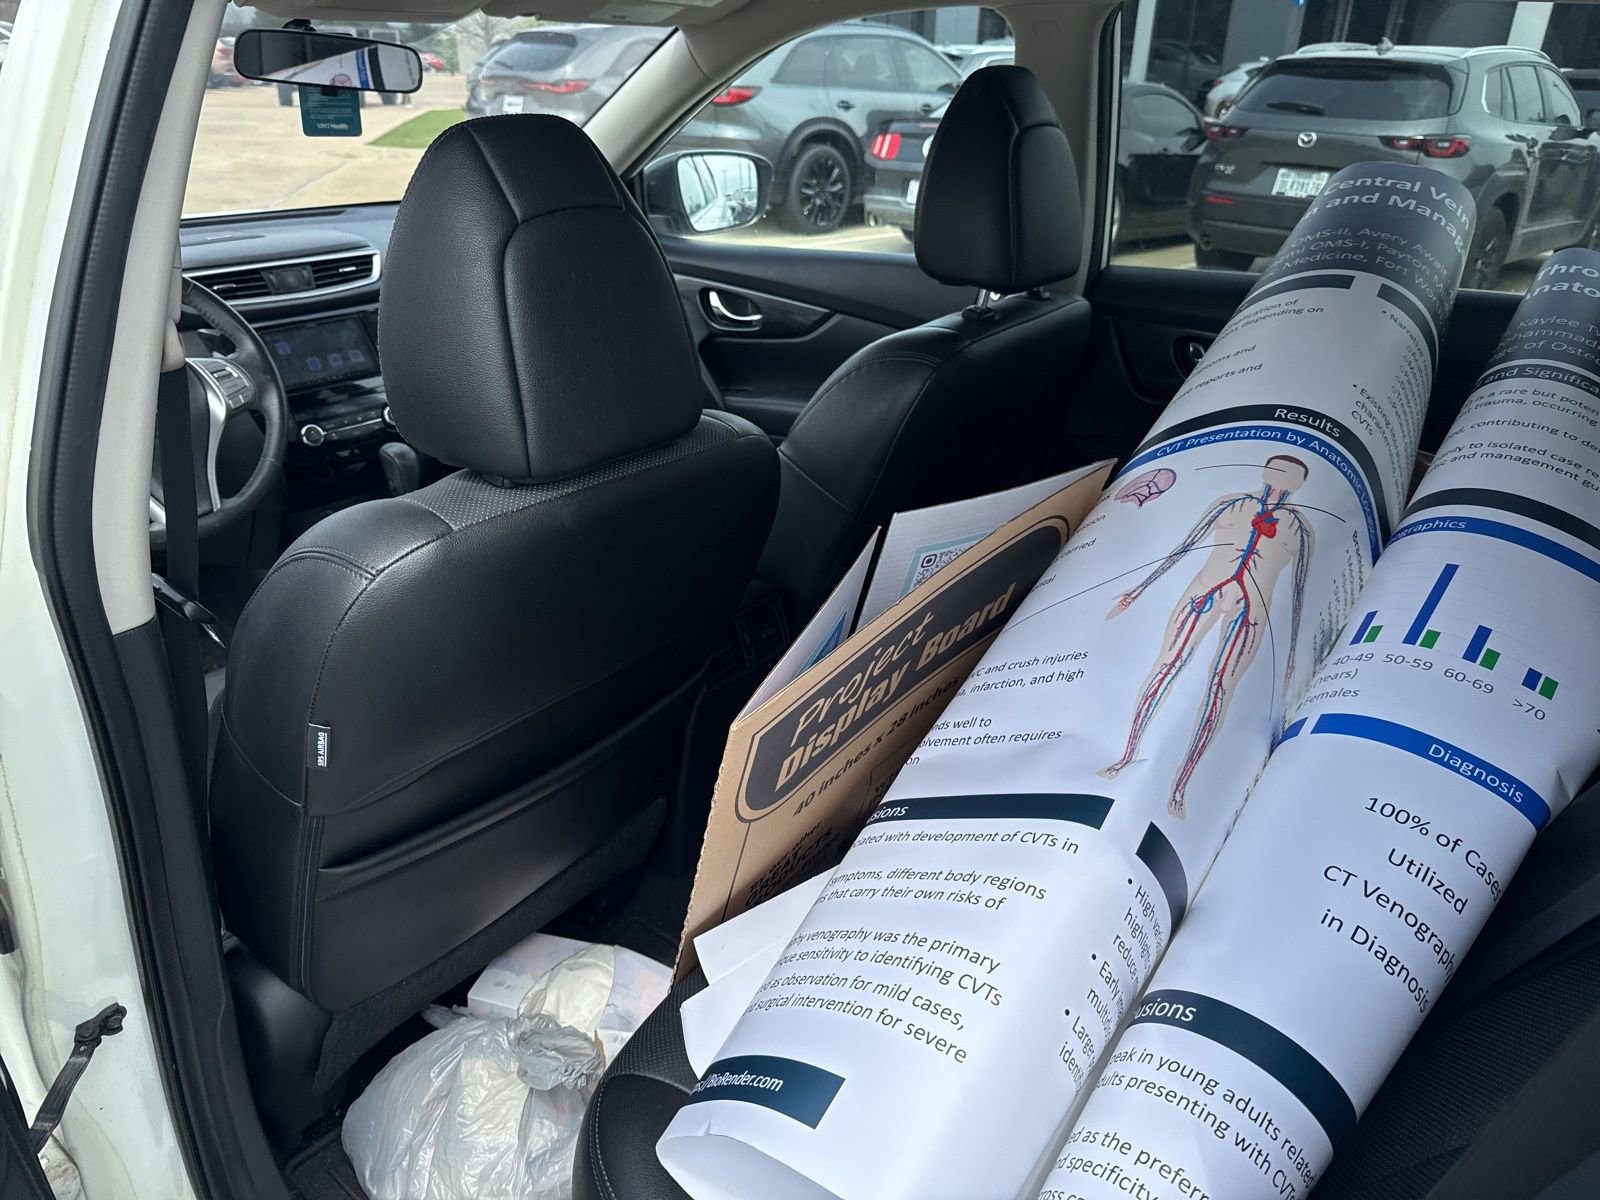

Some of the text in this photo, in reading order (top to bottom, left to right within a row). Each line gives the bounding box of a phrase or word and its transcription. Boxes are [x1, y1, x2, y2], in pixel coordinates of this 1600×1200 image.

[1324, 176, 1421, 196] Central
[1429, 185, 1470, 230] Vein
[1326, 192, 1380, 209] and
[1387, 195, 1466, 260] Manag
[1359, 227, 1410, 246] Avery
[1282, 251, 1368, 271] Medicine,
[1375, 255, 1409, 276] Fort
[1376, 242, 1431, 276] Payton
[1241, 306, 1304, 329] depending
[1307, 306, 1324, 314] on
[1285, 299, 1299, 308] of
[1233, 344, 1257, 357] and
[1523, 340, 1547, 350] of
[1194, 369, 1236, 390] reports
[1238, 362, 1263, 375] and
[1359, 388, 1391, 430] Existing
[1498, 388, 1529, 396] rare
[1531, 388, 1556, 400] but
[1273, 407, 1342, 438] Results
[1351, 410, 1374, 437] CVTs
[1474, 397, 1598, 428] trauma, occurring
[1470, 418, 1559, 437] contributing
[1562, 431, 1578, 442] to
[1156, 427, 1364, 496] CVT Presentation by Anatomic
[1449, 451, 1478, 464] and
[1480, 451, 1579, 481] management
[1468, 441, 1484, 450] to
[1487, 440, 1548, 457] isolated
[1550, 452, 1583, 470] case
[985, 664, 1007, 675] and
[1007, 656, 1040, 670] crush
[1041, 650, 1089, 665] injuries
[775, 582, 1016, 794] Display Board
[790, 611, 935, 748] Project
[970, 677, 1027, 694] infarction,
[1029, 672, 1055, 686] and
[1056, 667, 1084, 683] high
[1332, 652, 1547, 721] 40-49 50-59 60-69 >70
[952, 716, 977, 729] well
[980, 717, 992, 728] to
[973, 732, 1006, 745] often
[1008, 729, 1063, 744] requires
[317, 731, 325, 755] AIRBAG
[792, 790, 816, 818] 40
[817, 743, 872, 796] inches
[886, 713, 909, 735] 28
[1428, 742, 1524, 804] Diagnosis
[884, 831, 911, 843] with
[912, 830, 998, 844] development
[1001, 830, 1020, 843] of
[1020, 831, 1059, 848] CVTs
[1061, 837, 1080, 854] in
[1364, 796, 1502, 903] 100% of Cases
[886, 867, 943, 881] different
[944, 870, 982, 885] body
[983, 873, 1047, 900] regions
[1322, 864, 1359, 888] CT
[1387, 847, 1469, 915] Utilized
[828, 888, 849, 901] that
[849, 887, 881, 899] carry
[880, 886, 914, 898] their
[913, 889, 944, 900] own
[946, 889, 982, 905] risks
[984, 896, 1008, 911] of
[1134, 885, 1155, 924] High
[806, 927, 873, 943] venography
[873, 931, 901, 943] was
[902, 932, 928, 947] the
[928, 939, 1002, 975] primary
[1320, 908, 1430, 1014] in Diagnosis
[796, 946, 854, 962] sensitivity
[854, 949, 870, 962] to
[870, 949, 954, 986] identifying
[957, 973, 1004, 1007] CVTs
[1098, 960, 1122, 1001] Early
[781, 972, 849, 988] observation
[851, 975, 874, 992] for
[872, 983, 913, 1003] mild
[912, 994, 966, 1031] cases,
[758, 993, 794, 1012] surgical
[792, 993, 874, 1020] intervention
[874, 1007, 903, 1029] for
[902, 1022, 968, 1064] severe
[1124, 1074, 1231, 1140] presenting
[1233, 1131, 1271, 1175] with
[1137, 1048, 1155, 1064] in
[1156, 1055, 1221, 1096] young
[1222, 1086, 1281, 1142] adults
[1280, 1136, 1317, 1192] related
[1081, 1129, 1100, 1144] as
[1100, 1130, 1132, 1156] the
